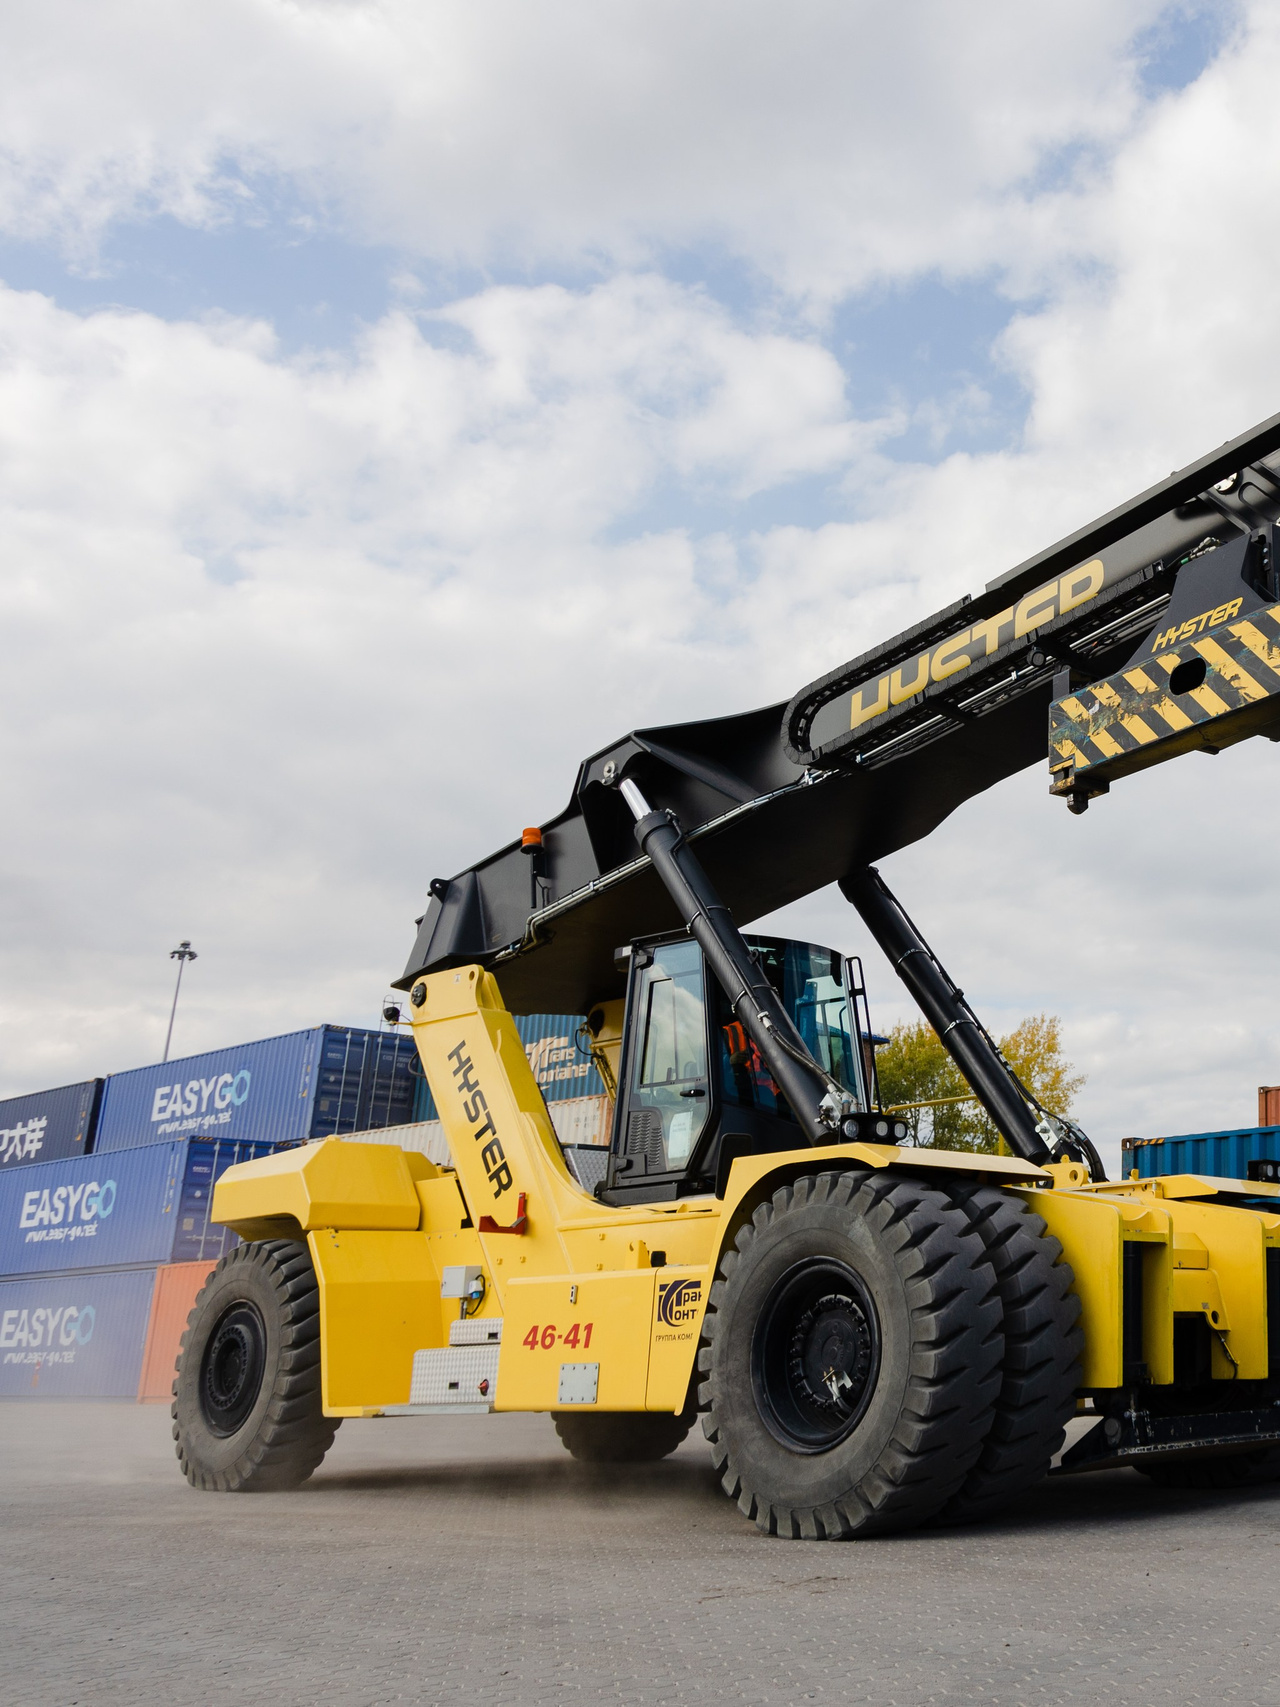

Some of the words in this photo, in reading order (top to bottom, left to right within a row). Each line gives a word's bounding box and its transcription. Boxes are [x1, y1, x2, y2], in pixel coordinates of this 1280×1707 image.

[1151, 597, 1244, 653] HYSTER
[540, 1036, 576, 1069] Trans
[151, 1069, 252, 1122] EASYGO
[447, 1040, 513, 1200] HYSTER
[19, 1180, 117, 1228] EASYGO
[0, 1305, 96, 1347] EASYGO
[523, 1323, 594, 1350] 46-41
